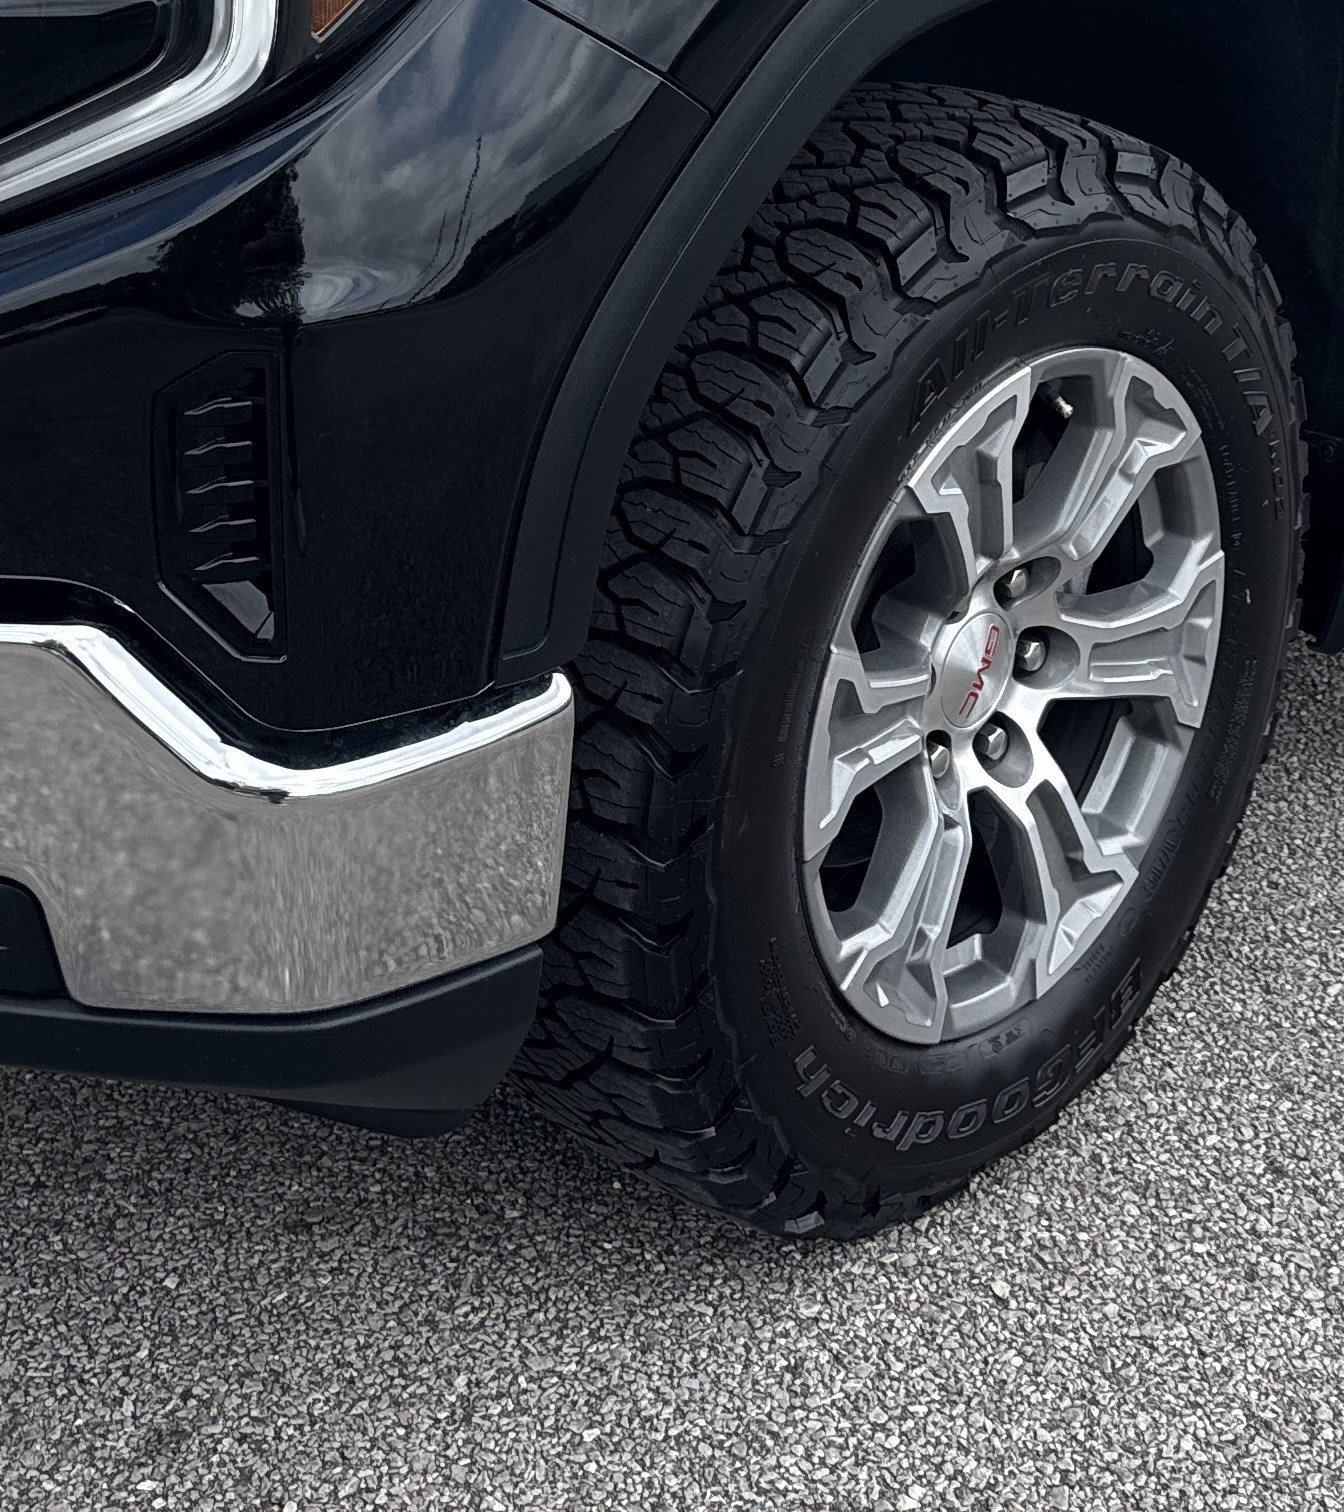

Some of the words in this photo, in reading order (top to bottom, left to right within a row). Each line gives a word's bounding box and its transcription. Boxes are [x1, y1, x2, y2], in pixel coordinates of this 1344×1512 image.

[907, 261, 1225, 436] All-Terrain
[957, 624, 1000, 719] GMC
[794, 956, 1142, 1152] BFGoodrich
